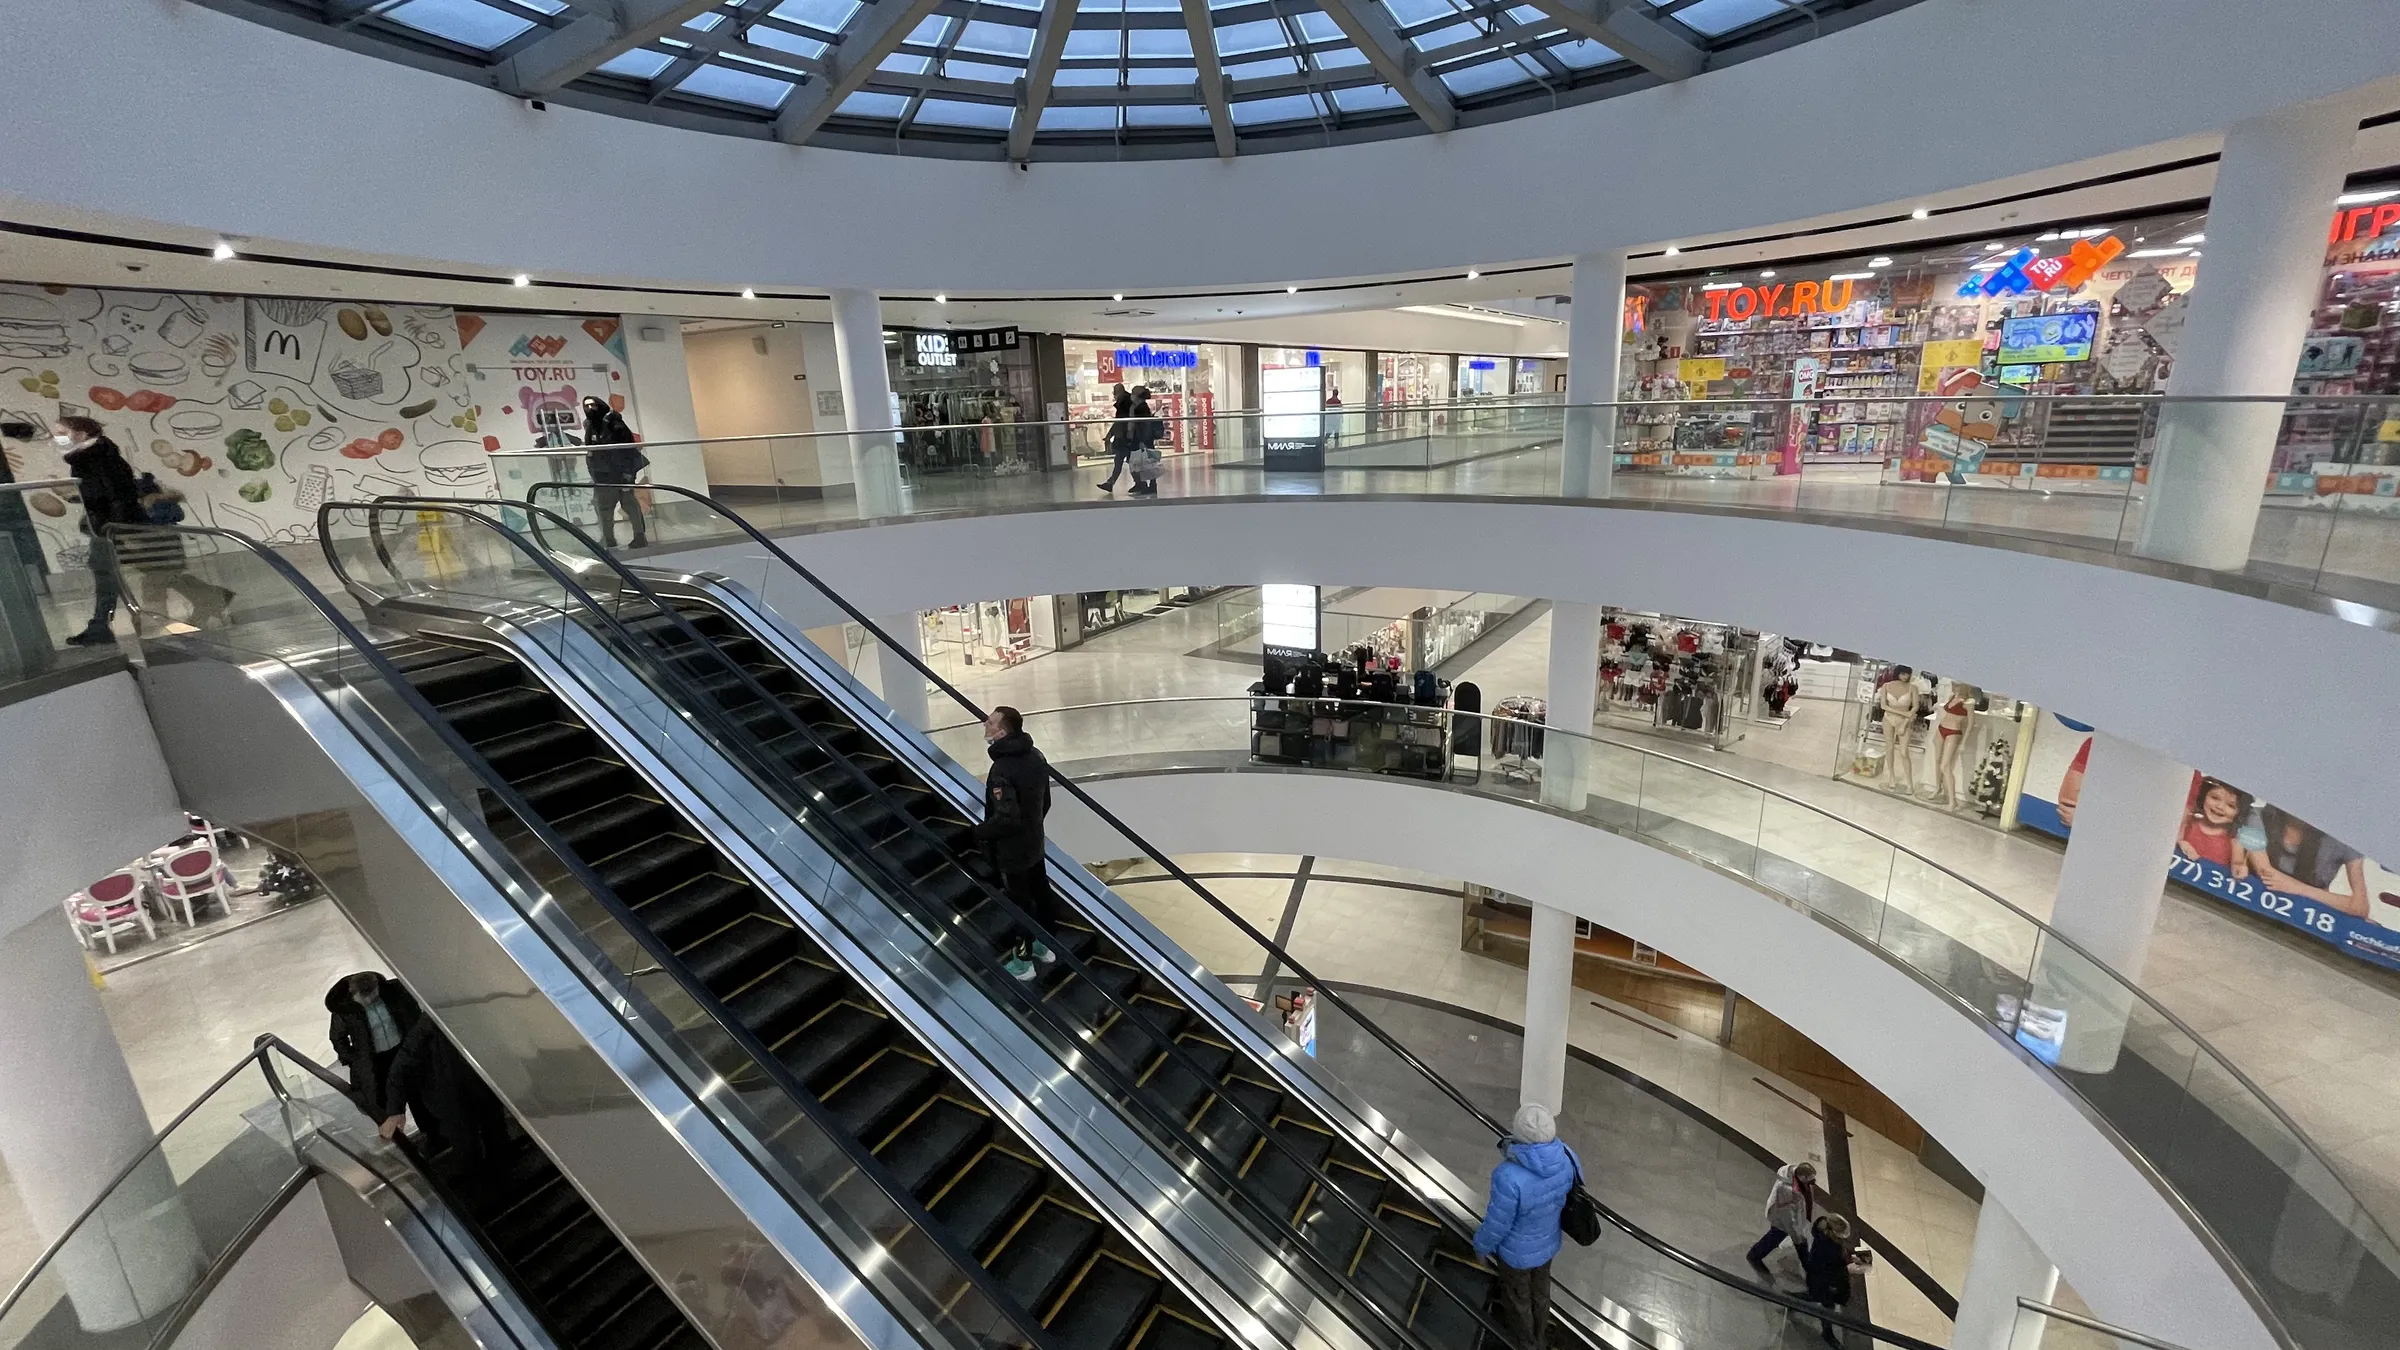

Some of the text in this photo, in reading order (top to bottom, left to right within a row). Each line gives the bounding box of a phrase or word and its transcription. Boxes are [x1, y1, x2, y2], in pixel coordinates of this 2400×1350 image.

[1705, 278, 1854, 323] TOY.RU
[916, 333, 949, 353] KID
[918, 353, 957, 366] OUTLET
[1115, 343, 1198, 369] mothercare
[512, 367, 576, 381] TOY.RU
[2208, 870, 2253, 902] 312
[2260, 891, 2294, 918] 02
[2303, 907, 2336, 933] 18
